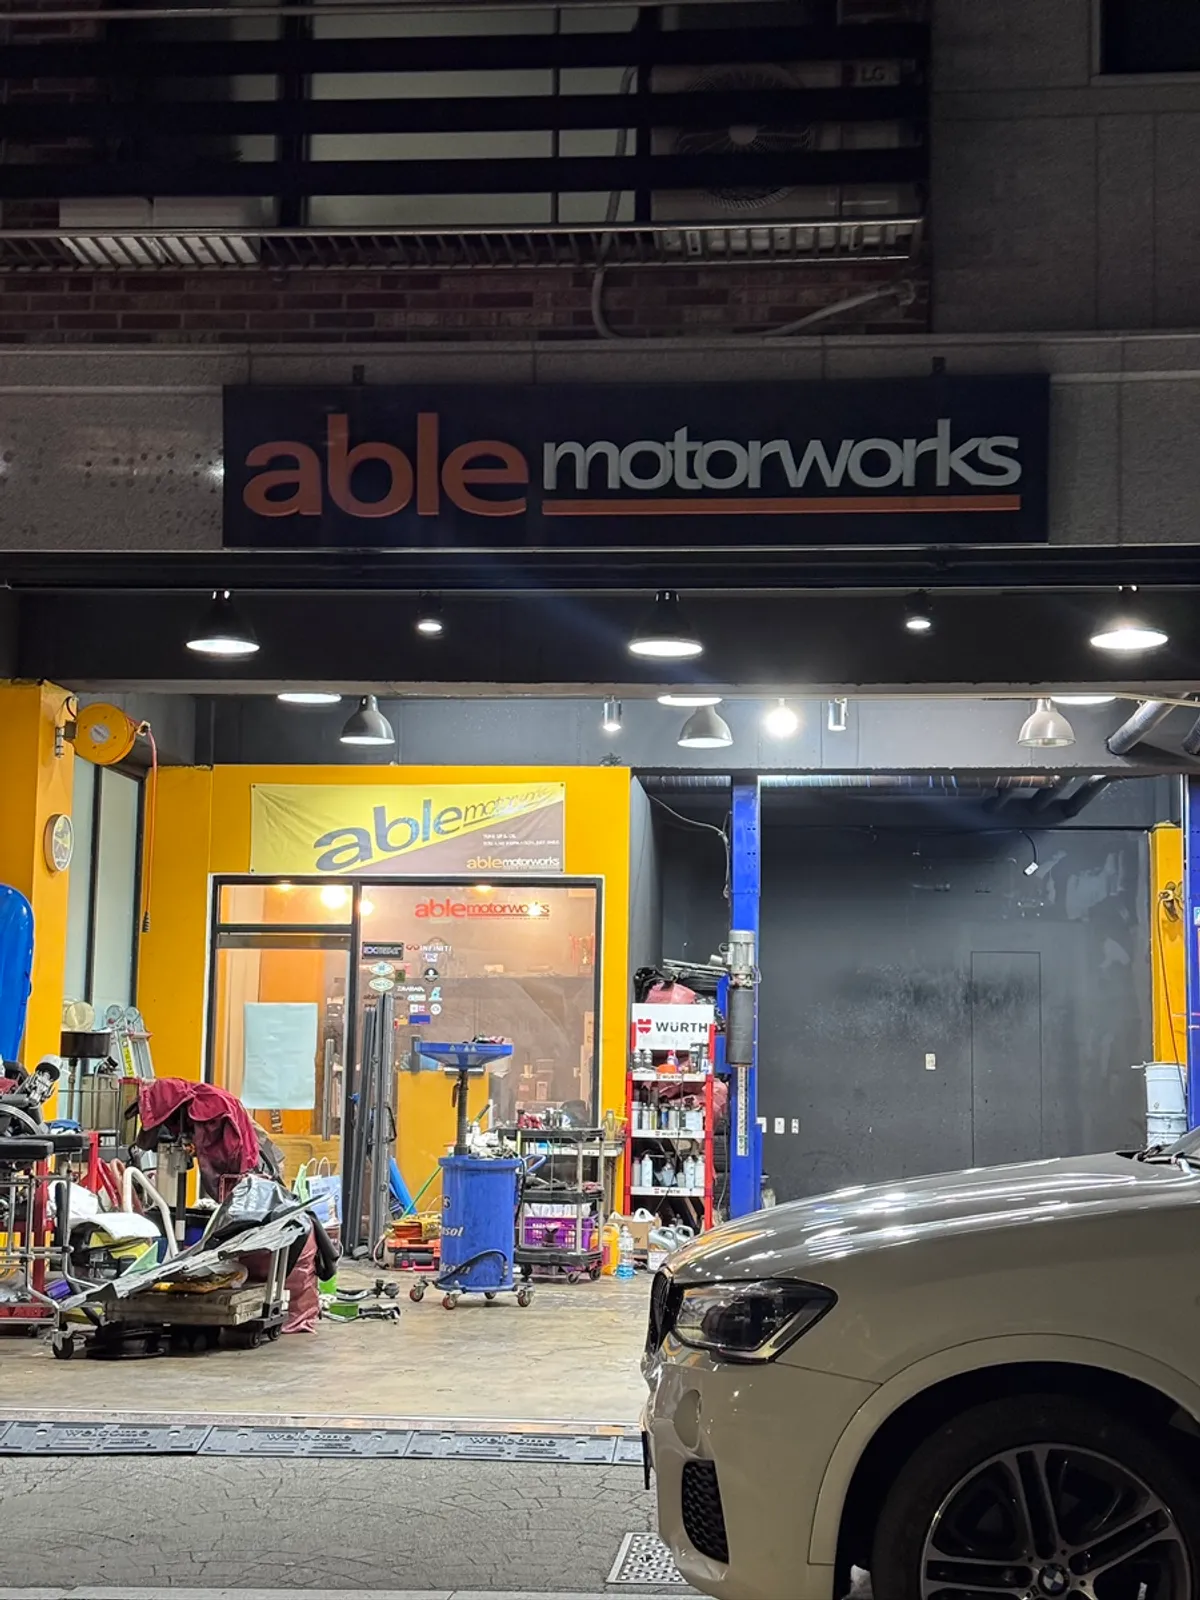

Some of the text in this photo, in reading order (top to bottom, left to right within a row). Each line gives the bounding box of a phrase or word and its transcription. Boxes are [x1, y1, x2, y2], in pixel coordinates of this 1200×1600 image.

[861, 66, 885, 82] LG
[243, 413, 1022, 517] able motorworks
[313, 799, 462, 872] able
[466, 856, 560, 869] able motorworks
[415, 898, 467, 919] able
[656, 1021, 708, 1033] WÜRTH
